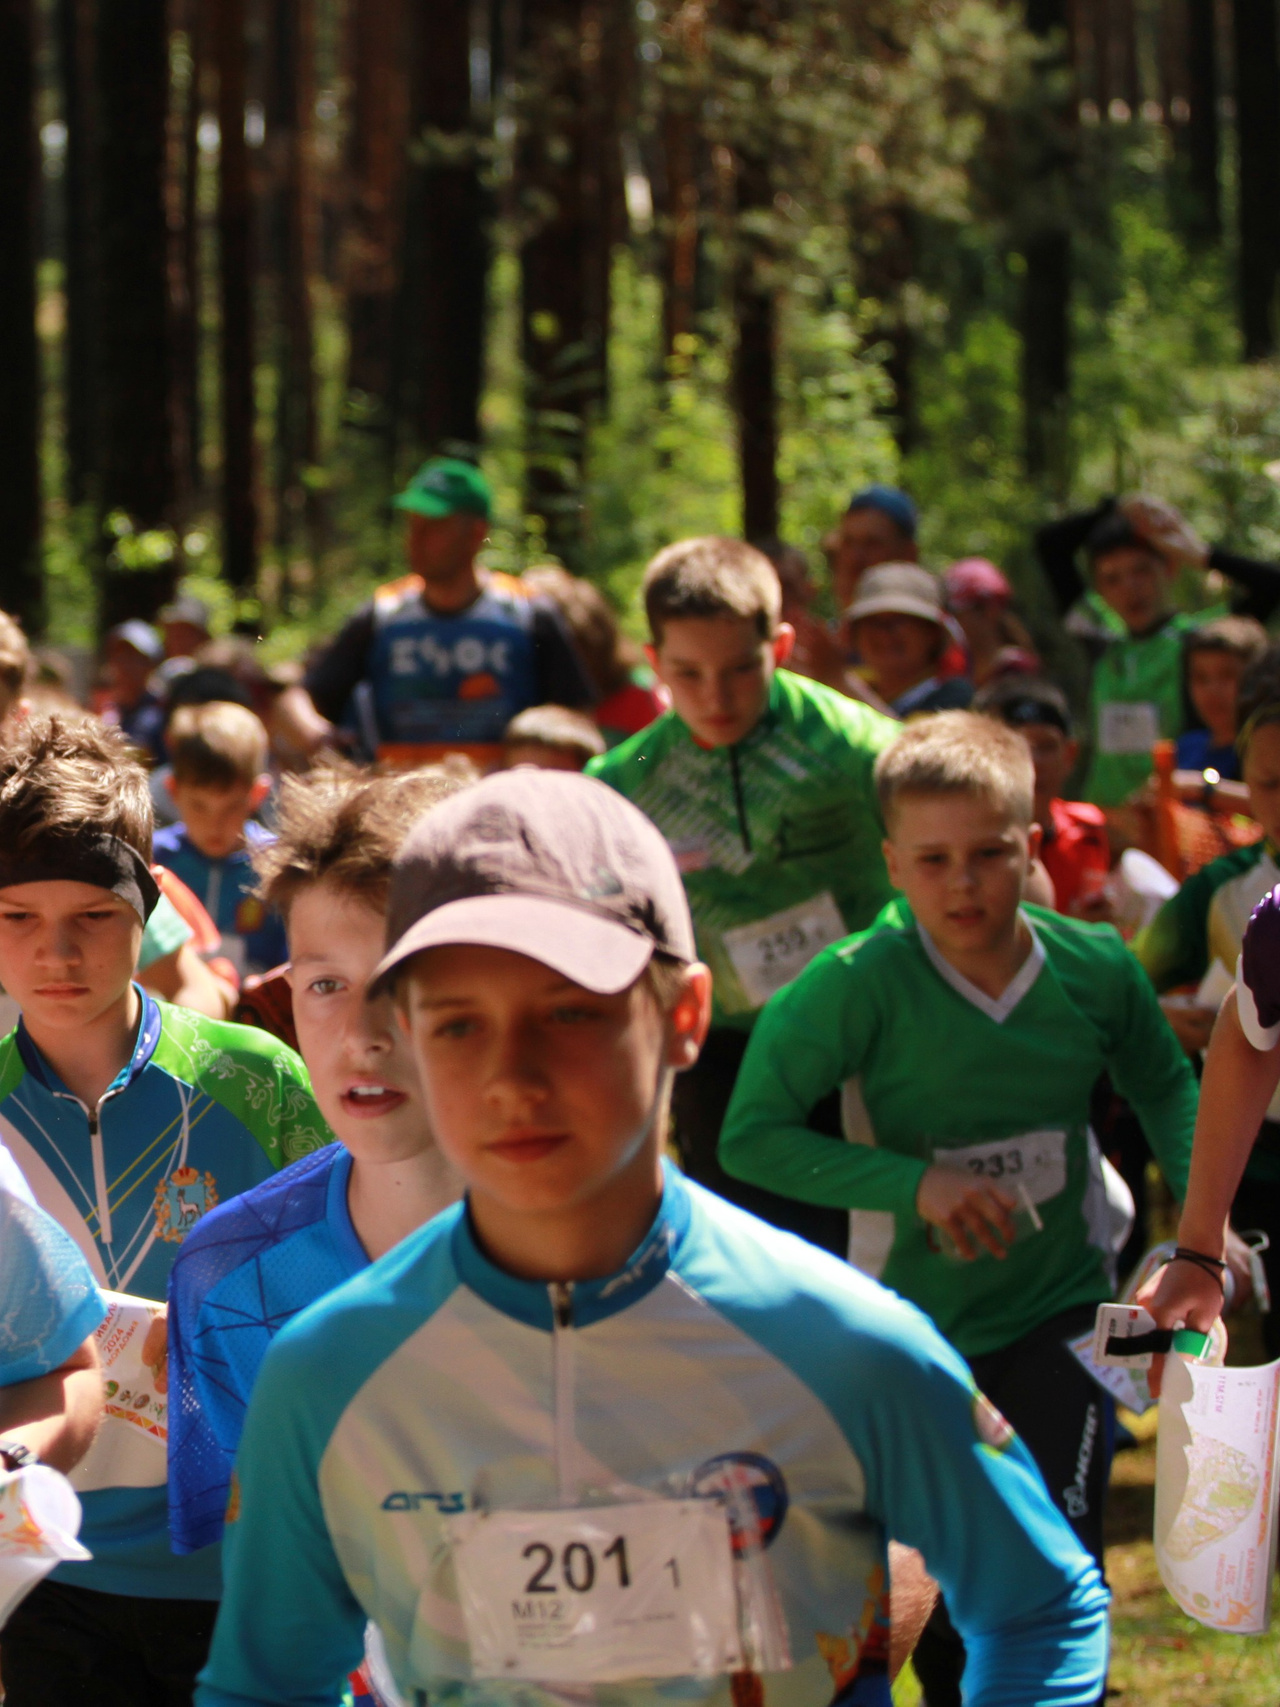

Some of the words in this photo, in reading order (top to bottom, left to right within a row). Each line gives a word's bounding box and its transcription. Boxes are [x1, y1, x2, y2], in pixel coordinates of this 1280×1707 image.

[103, 1327, 125, 1354] 2024
[106, 1320, 139, 1367] МОРДОВИЯ
[522, 1535, 631, 1593] 201
[663, 1556, 682, 1589] 1
